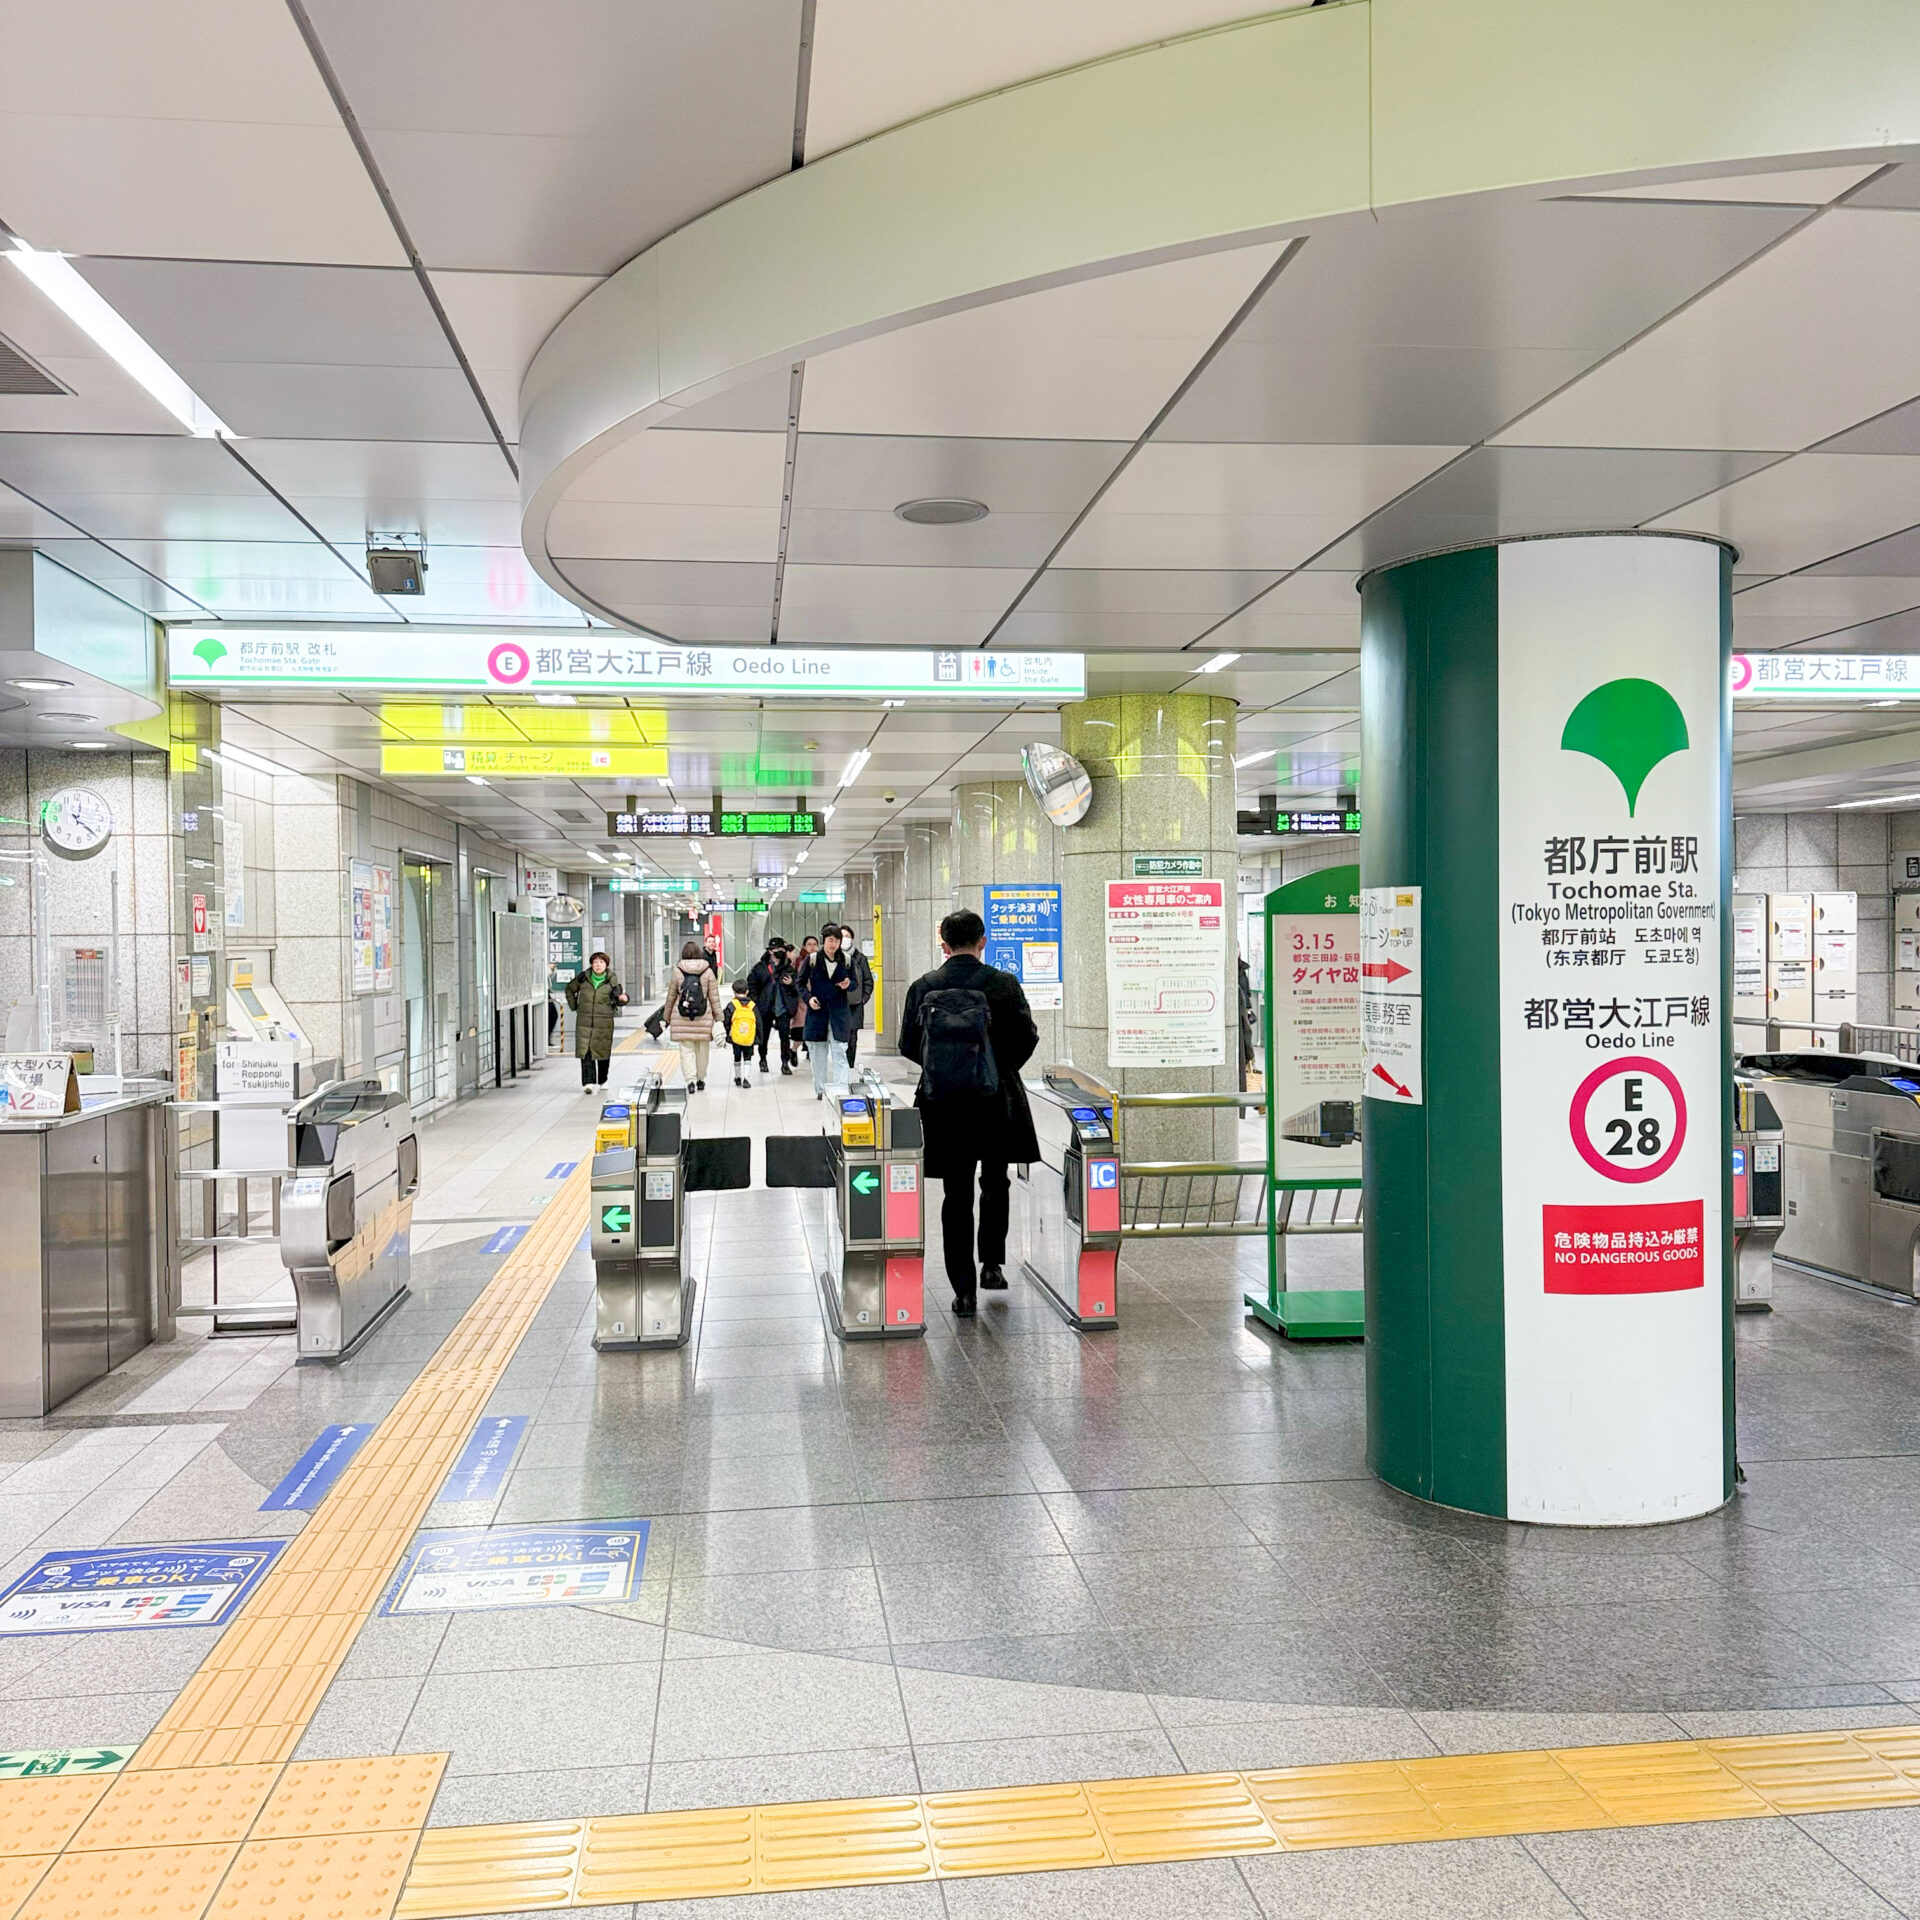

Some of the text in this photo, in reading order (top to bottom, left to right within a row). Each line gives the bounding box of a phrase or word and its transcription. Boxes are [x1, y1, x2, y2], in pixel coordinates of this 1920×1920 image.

[240, 642, 337, 656] 都庁前駅 改札
[504, 657, 513, 670] E
[536, 648, 712, 676] 都営大江戸線
[732, 657, 831, 675] Oedo Line
[1758, 658, 1908, 682] 都営大江戸線
[1544, 835, 1698, 876] 都庁前駅
[758, 878, 782, 887] 12:22
[1548, 880, 1698, 900] Tochomae Sta.
[991, 903, 1036, 913] タッチ決済
[1123, 894, 1212, 906] 女性専用車のご案内
[1512, 901, 1716, 925] (Tokyo Metropolitan Government)
[1293, 934, 1334, 950] 3.15
[1390, 939, 1413, 948] TOP UP
[1293, 967, 1359, 984] ダイヤ改
[1524, 995, 1710, 1030] 都営大江戸線
[1586, 1032, 1675, 1048] Oedo Line
[225, 1046, 231, 1057] 1
[222, 1060, 278, 1069] for Shinjuku
[242, 1070, 282, 1078] Roppongi
[242, 1080, 290, 1089] Tsukijishijo
[1624, 1078, 1642, 1112] E
[1605, 1118, 1661, 1156] 28
[1090, 1162, 1115, 1186] IC
[1554, 1226, 1698, 1249] 危険物品持込み厳禁
[1555, 1247, 1698, 1264] NO DANGEROUS GOODS
[72, 1572, 198, 1588] ご乗車OK!
[466, 1579, 516, 1588] VISA
[58, 1600, 112, 1610] VISA
